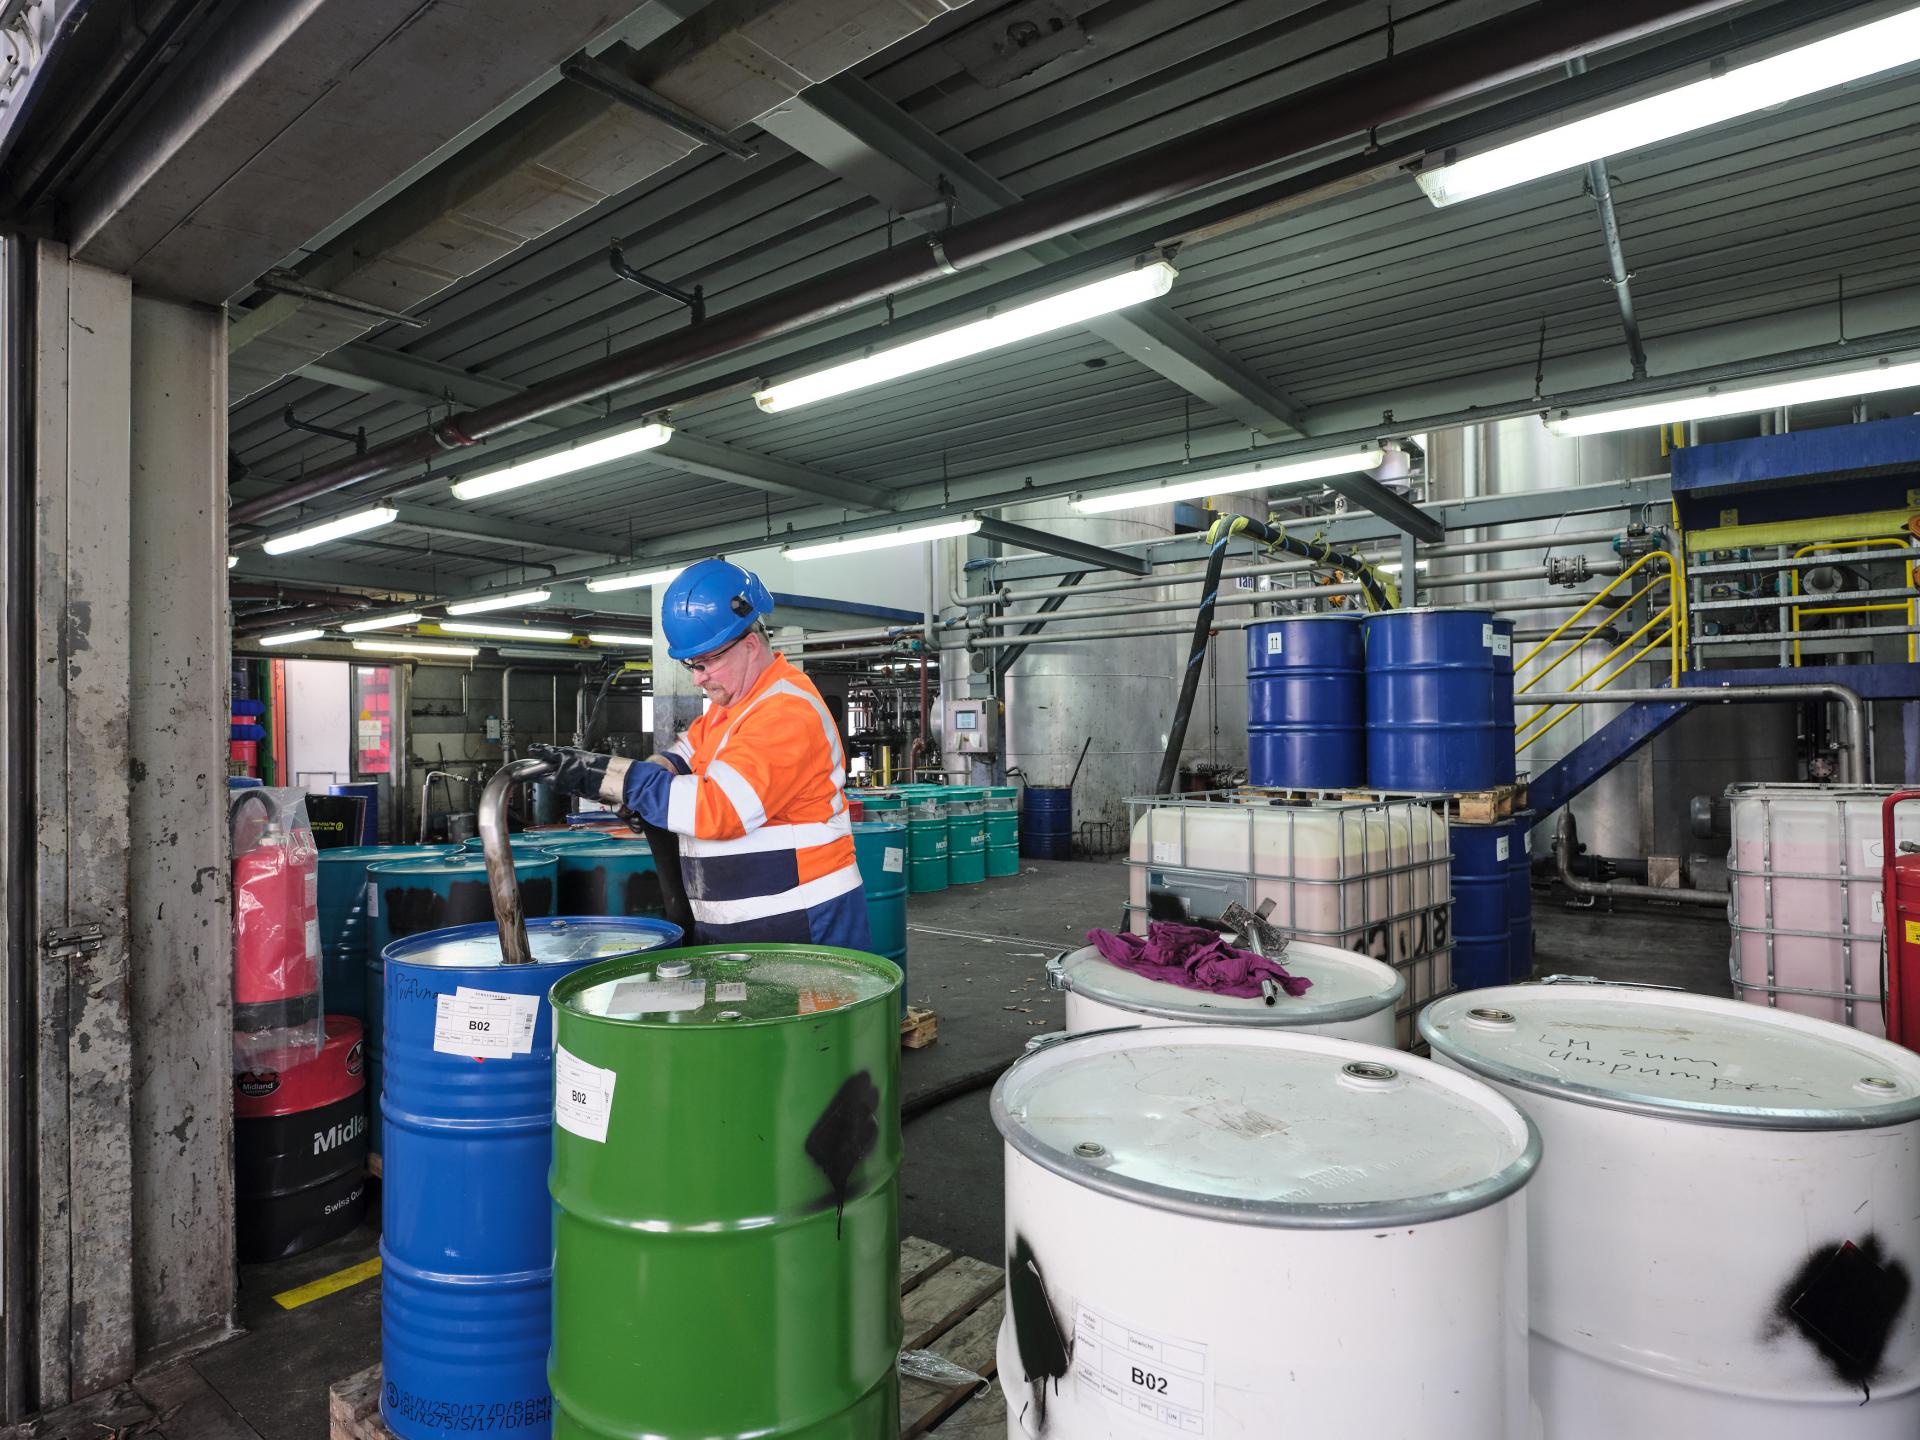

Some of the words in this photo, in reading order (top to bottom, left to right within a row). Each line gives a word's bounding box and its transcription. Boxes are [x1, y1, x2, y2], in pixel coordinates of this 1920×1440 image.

[468, 1020, 491, 1032] B02
[242, 1082, 274, 1091] Midland
[571, 1090, 587, 1105] B02
[324, 1196, 350, 1215] Swiss
[1131, 1366, 1168, 1395] B02
